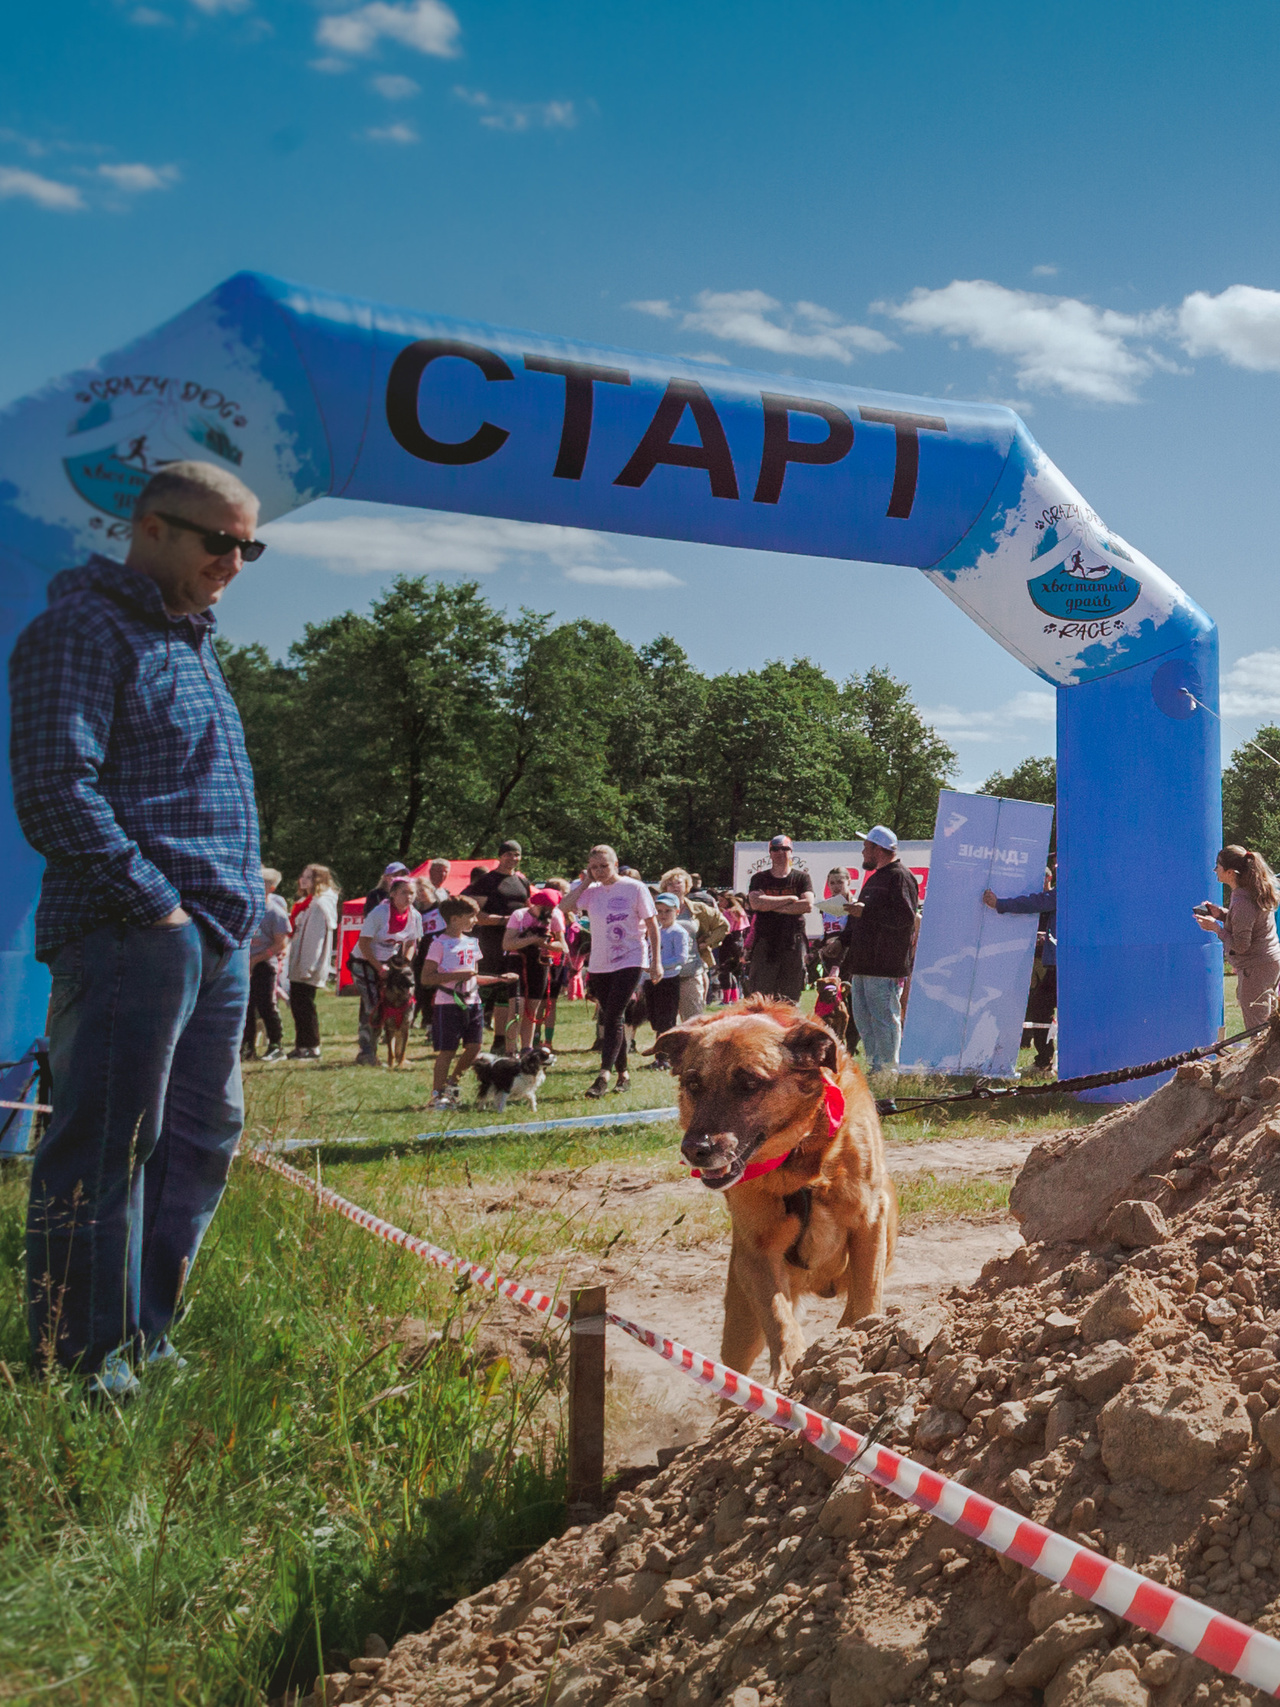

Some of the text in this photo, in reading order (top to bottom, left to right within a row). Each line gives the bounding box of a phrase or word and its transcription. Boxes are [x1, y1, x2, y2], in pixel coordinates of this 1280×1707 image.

[89, 375, 240, 419] CRAZY DOG
[386, 338, 948, 520] СТАРТ
[1042, 503, 1080, 525] CRAZY
[1041, 579, 1129, 594] хвостатый
[1065, 594, 1111, 614] драйв
[1058, 621, 1113, 641] RACE
